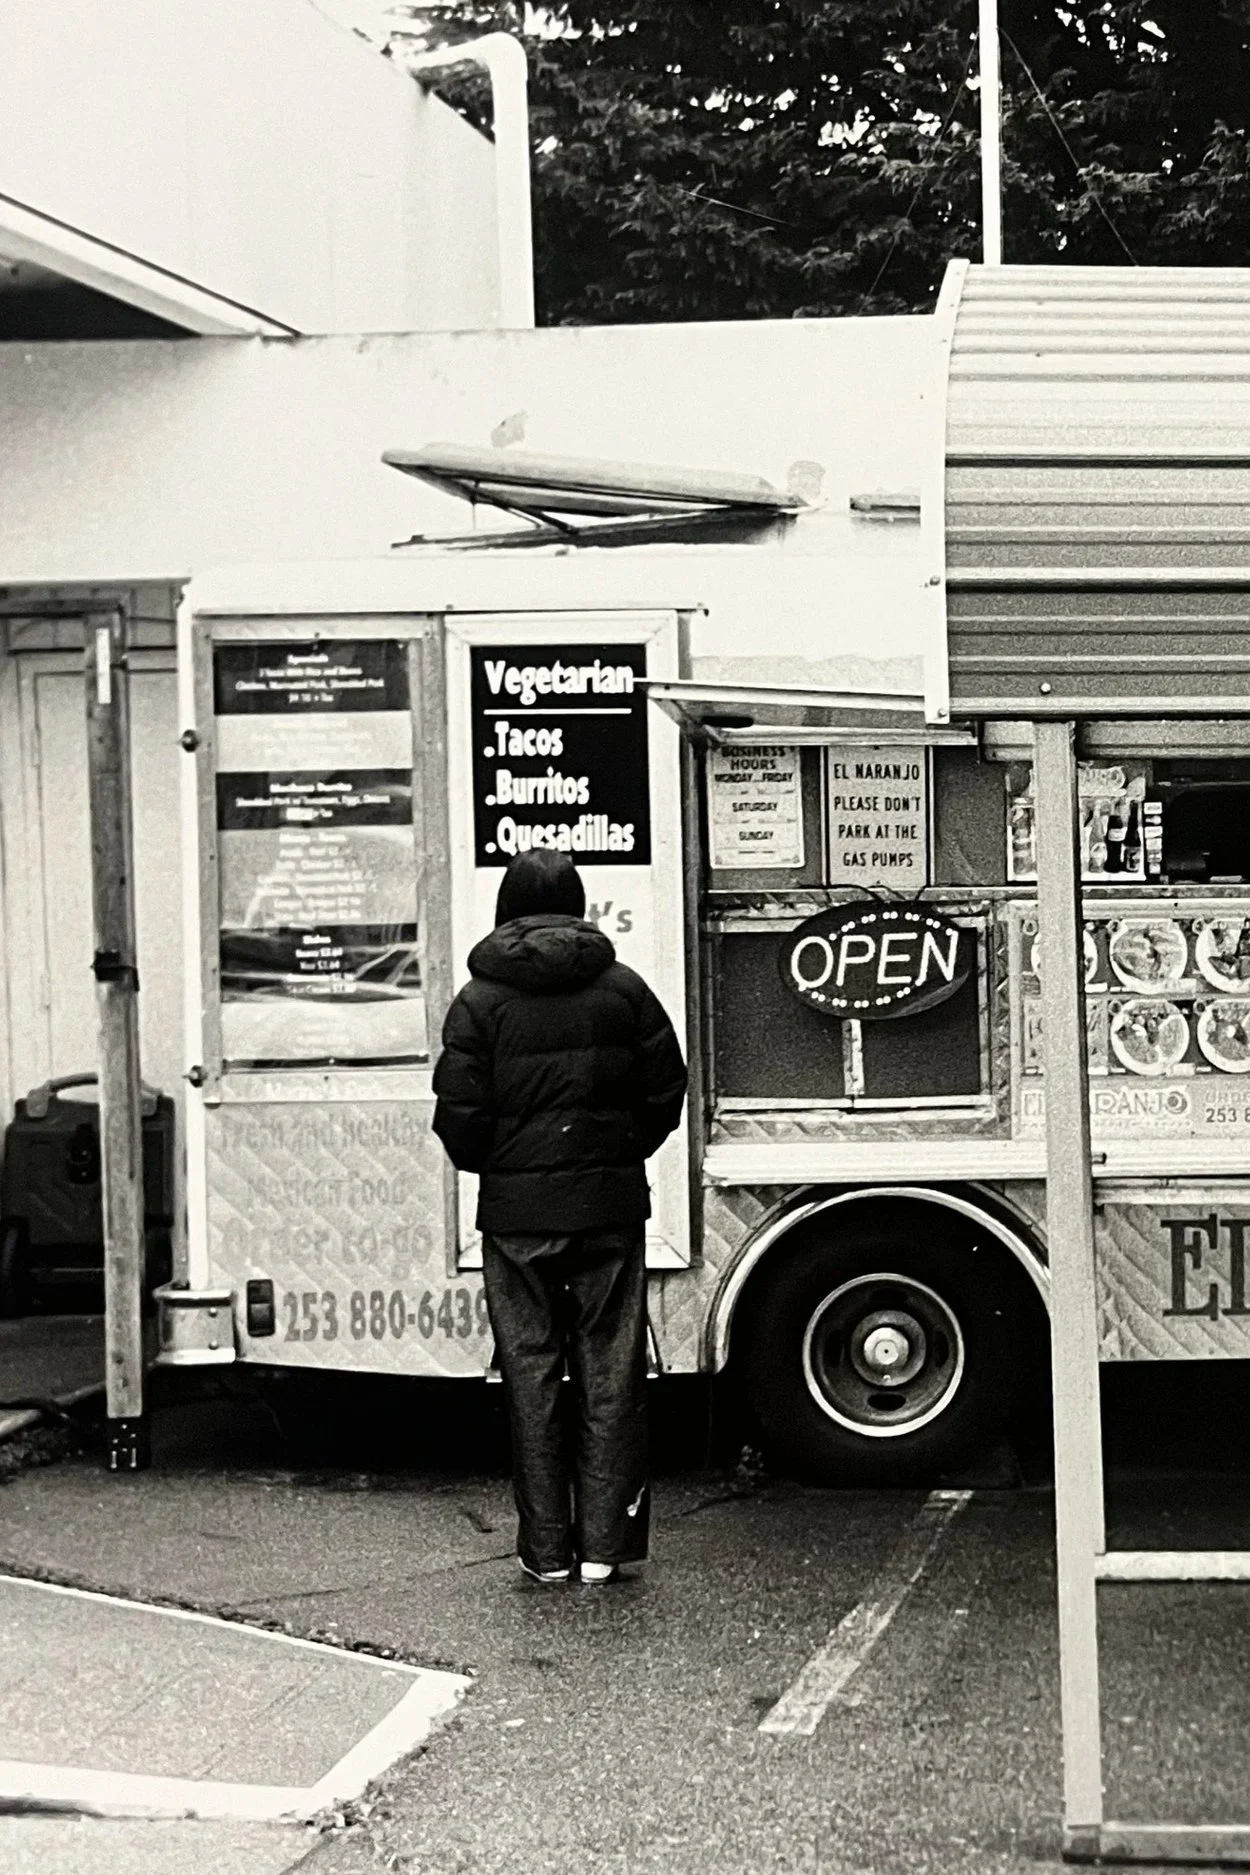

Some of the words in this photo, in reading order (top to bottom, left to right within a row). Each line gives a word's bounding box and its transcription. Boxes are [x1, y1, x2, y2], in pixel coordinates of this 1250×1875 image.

[484, 659, 635, 706] Vegetarian
[730, 759, 777, 771] HOURS
[834, 763, 850, 780] EL
[856, 763, 920, 781] NARANJO
[732, 802, 778, 812] SATURDAY
[834, 796, 879, 811] PLEASE
[884, 796, 921, 812] DON'T
[839, 824, 870, 839] PARK
[875, 824, 890, 839] AT
[895, 824, 918, 840] THE
[843, 852, 867, 867] GAS
[872, 852, 914, 868] PUMPS
[790, 931, 959, 989] OPEN
[1205, 1108, 1238, 1123] 253
[283, 1290, 339, 1342] 253
